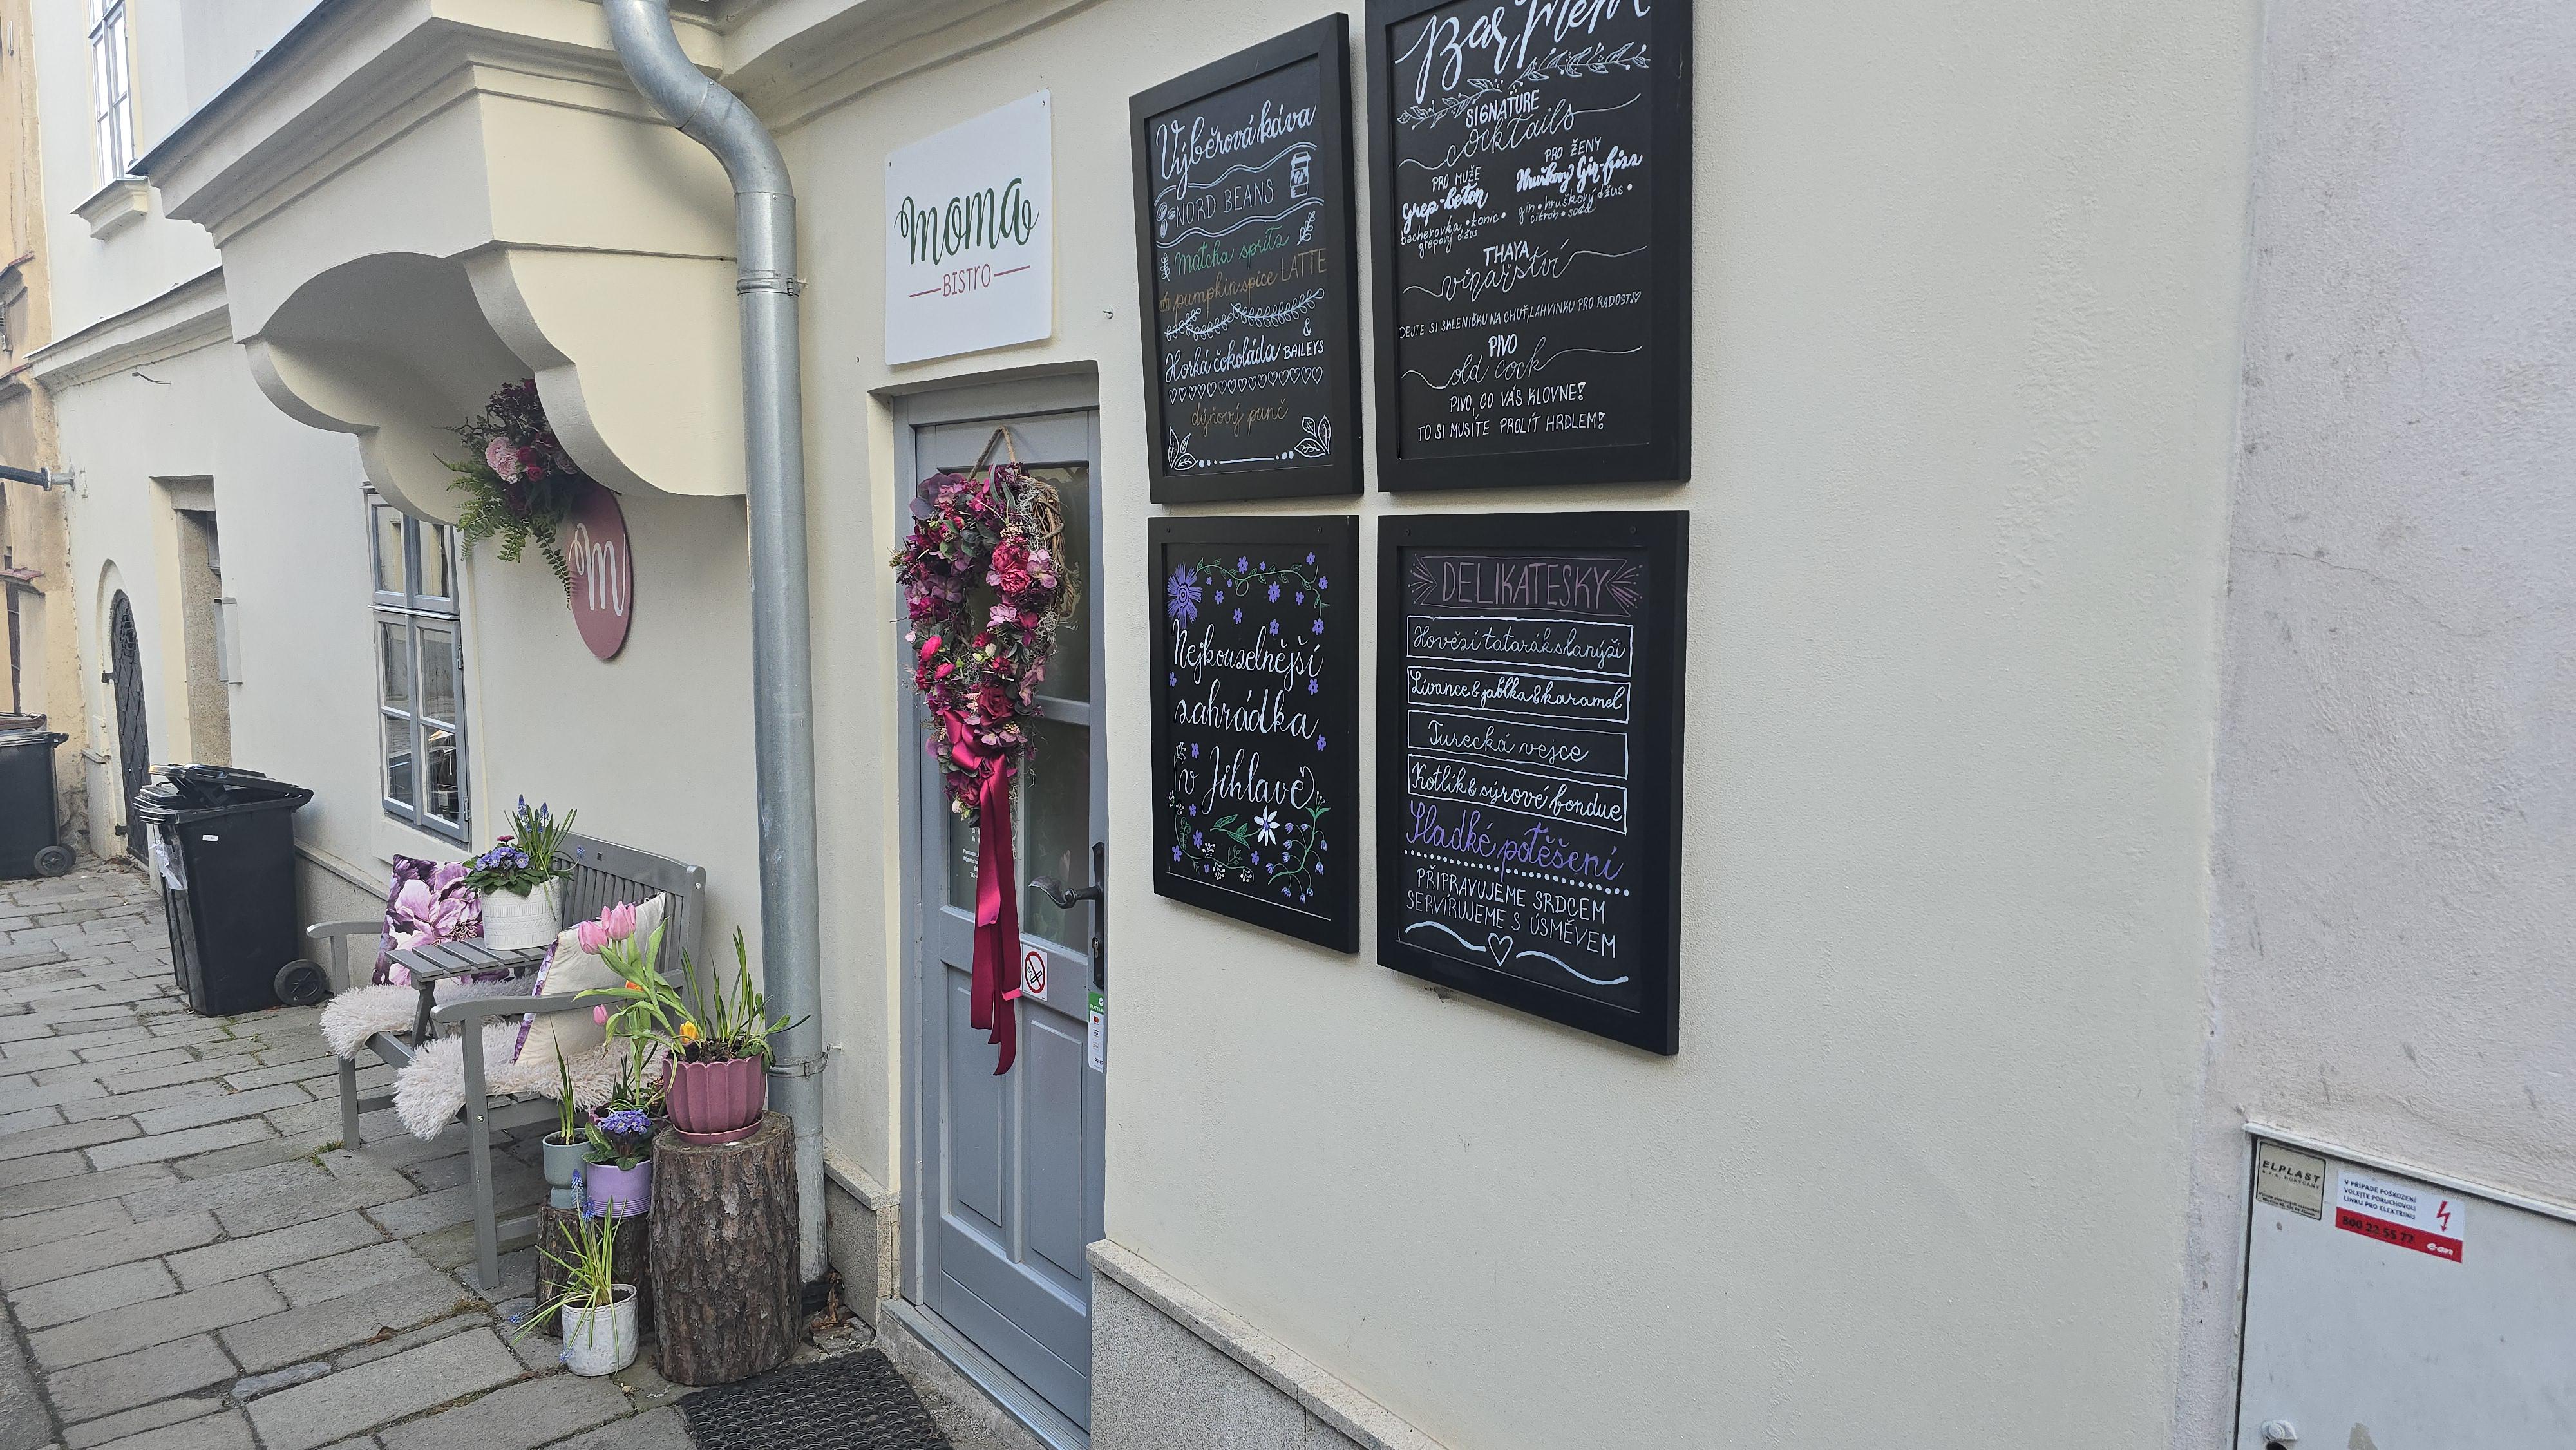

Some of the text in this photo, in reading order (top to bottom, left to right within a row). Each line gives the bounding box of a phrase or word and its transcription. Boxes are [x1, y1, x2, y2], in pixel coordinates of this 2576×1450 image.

[1395, 0, 1651, 104] Bar Men
[1465, 89, 1540, 129] SIGNATURE
[1155, 100, 1317, 200] Výběrová káva
[1446, 98, 1576, 167] cocktails
[1544, 136, 1602, 162] PRO ŽENY
[1175, 178, 1274, 227] NORD BEANS
[1432, 174, 1449, 192] PRO
[1518, 202, 1535, 225] gin
[1597, 183, 1624, 199] džus
[1483, 240, 1530, 267] THAYA
[1173, 248, 1327, 326] pumpkin spice LATTE
[1399, 324, 1425, 339] DEJTE
[1428, 322, 1438, 334] SI
[1441, 312, 1488, 332] SKLENIČKU
[1489, 312, 1501, 325] NA
[1577, 296, 1595, 312] PRO
[1165, 346, 1212, 384] Horká
[1213, 334, 1281, 373] čokoláda
[1283, 339, 1324, 360] BAILEYS
[1448, 336, 1548, 386] old cock
[1488, 333, 1517, 358] PIVO
[1479, 392, 1494, 410] CO
[1500, 384, 1523, 408] VÁS
[1527, 381, 1586, 407] KLOVNE!
[1191, 398, 1288, 437] dýňový punč
[1418, 411, 1606, 442] TO SI MUSÍTE PROLÍT HRDLEM!
[1443, 561, 1611, 610] DELIKATESKY
[1413, 625, 1482, 652] Hovězí
[1482, 625, 1553, 654] tatarák
[1174, 679, 1320, 739] zahrádka
[1480, 676, 1535, 708] jablka
[1540, 681, 1625, 710] karamel
[1428, 720, 1589, 764] Turecká vejce
[1201, 746, 1315, 815] Jihlavě
[1479, 781, 1549, 810] sýrové
[1548, 784, 1623, 822] fondue
[1406, 800, 1624, 883] Sladké potěšení
[1416, 864, 1606, 925] PŘIPRAVUJEME SRDCEM
[1406, 890, 1616, 959] SERVÍRUJEME S ÚSMĚVEM
[2262, 1160, 2320, 1183] ELPLAST
[2344, 1187, 2370, 1199] VOLEJTE
[2344, 1196, 2363, 1205] LINKU
[2342, 1216, 2415, 1243] 800 22 55 77
